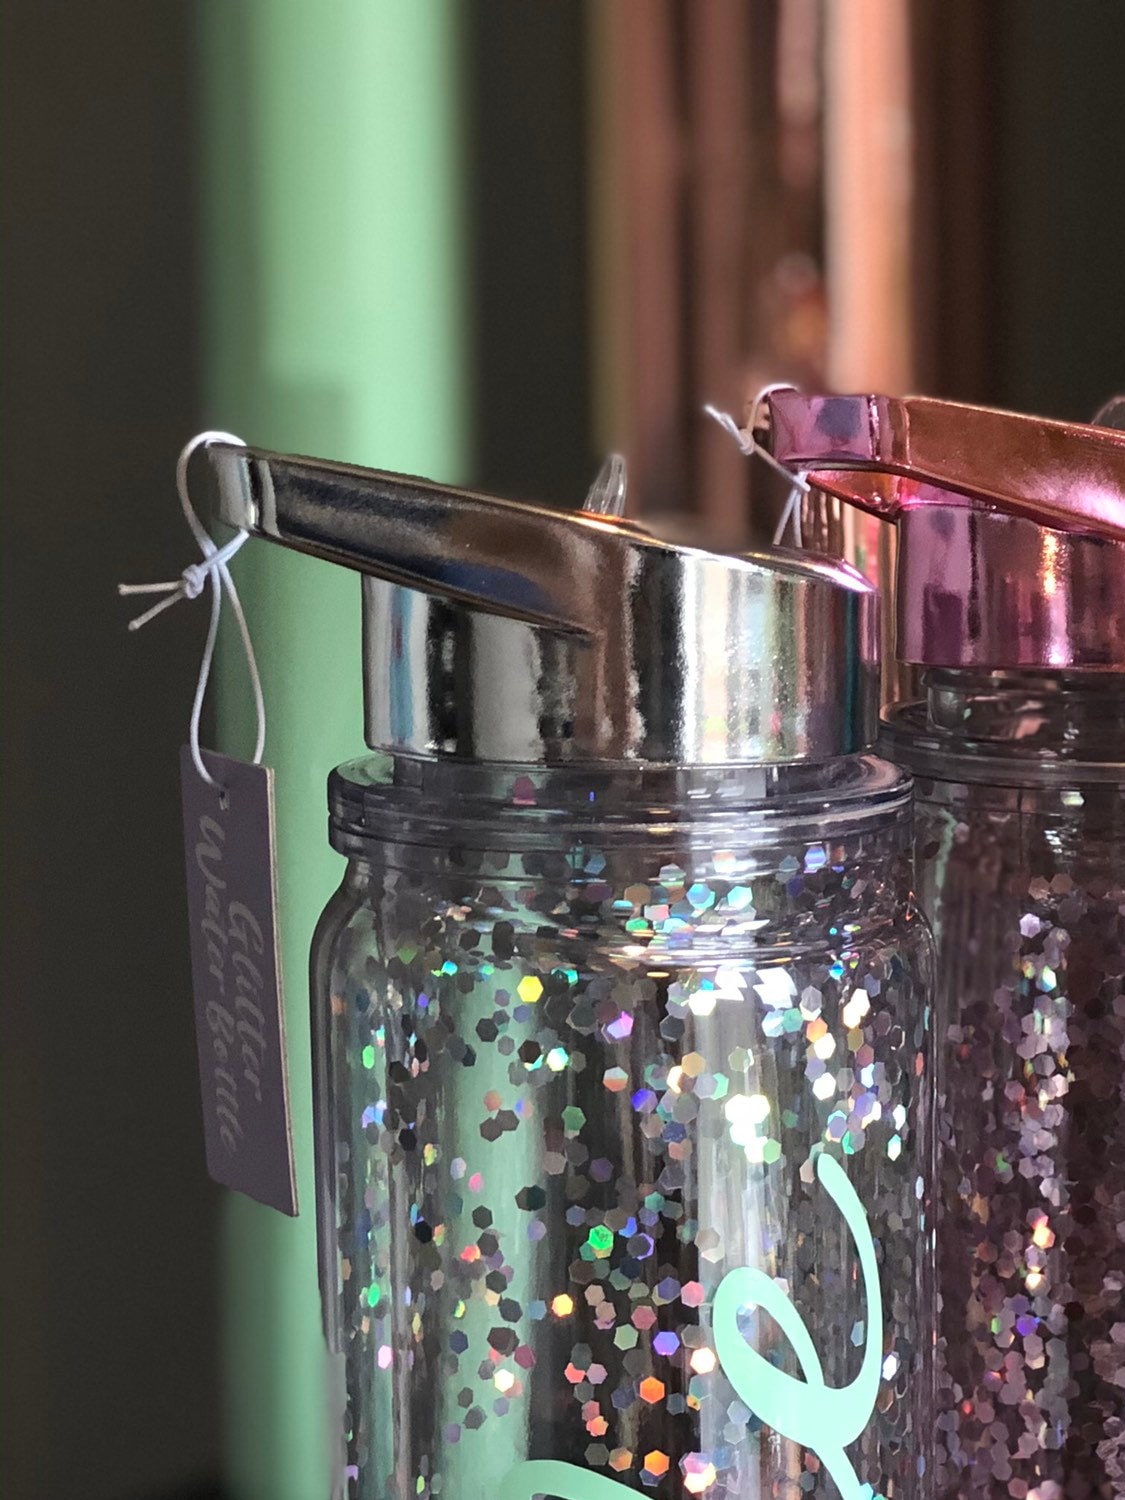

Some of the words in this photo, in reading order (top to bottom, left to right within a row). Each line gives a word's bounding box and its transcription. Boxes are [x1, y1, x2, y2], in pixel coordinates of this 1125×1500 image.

[195, 815, 227, 995] Water
[207, 1001, 244, 1153] Bottle
[228, 900, 266, 1101] Glitter
